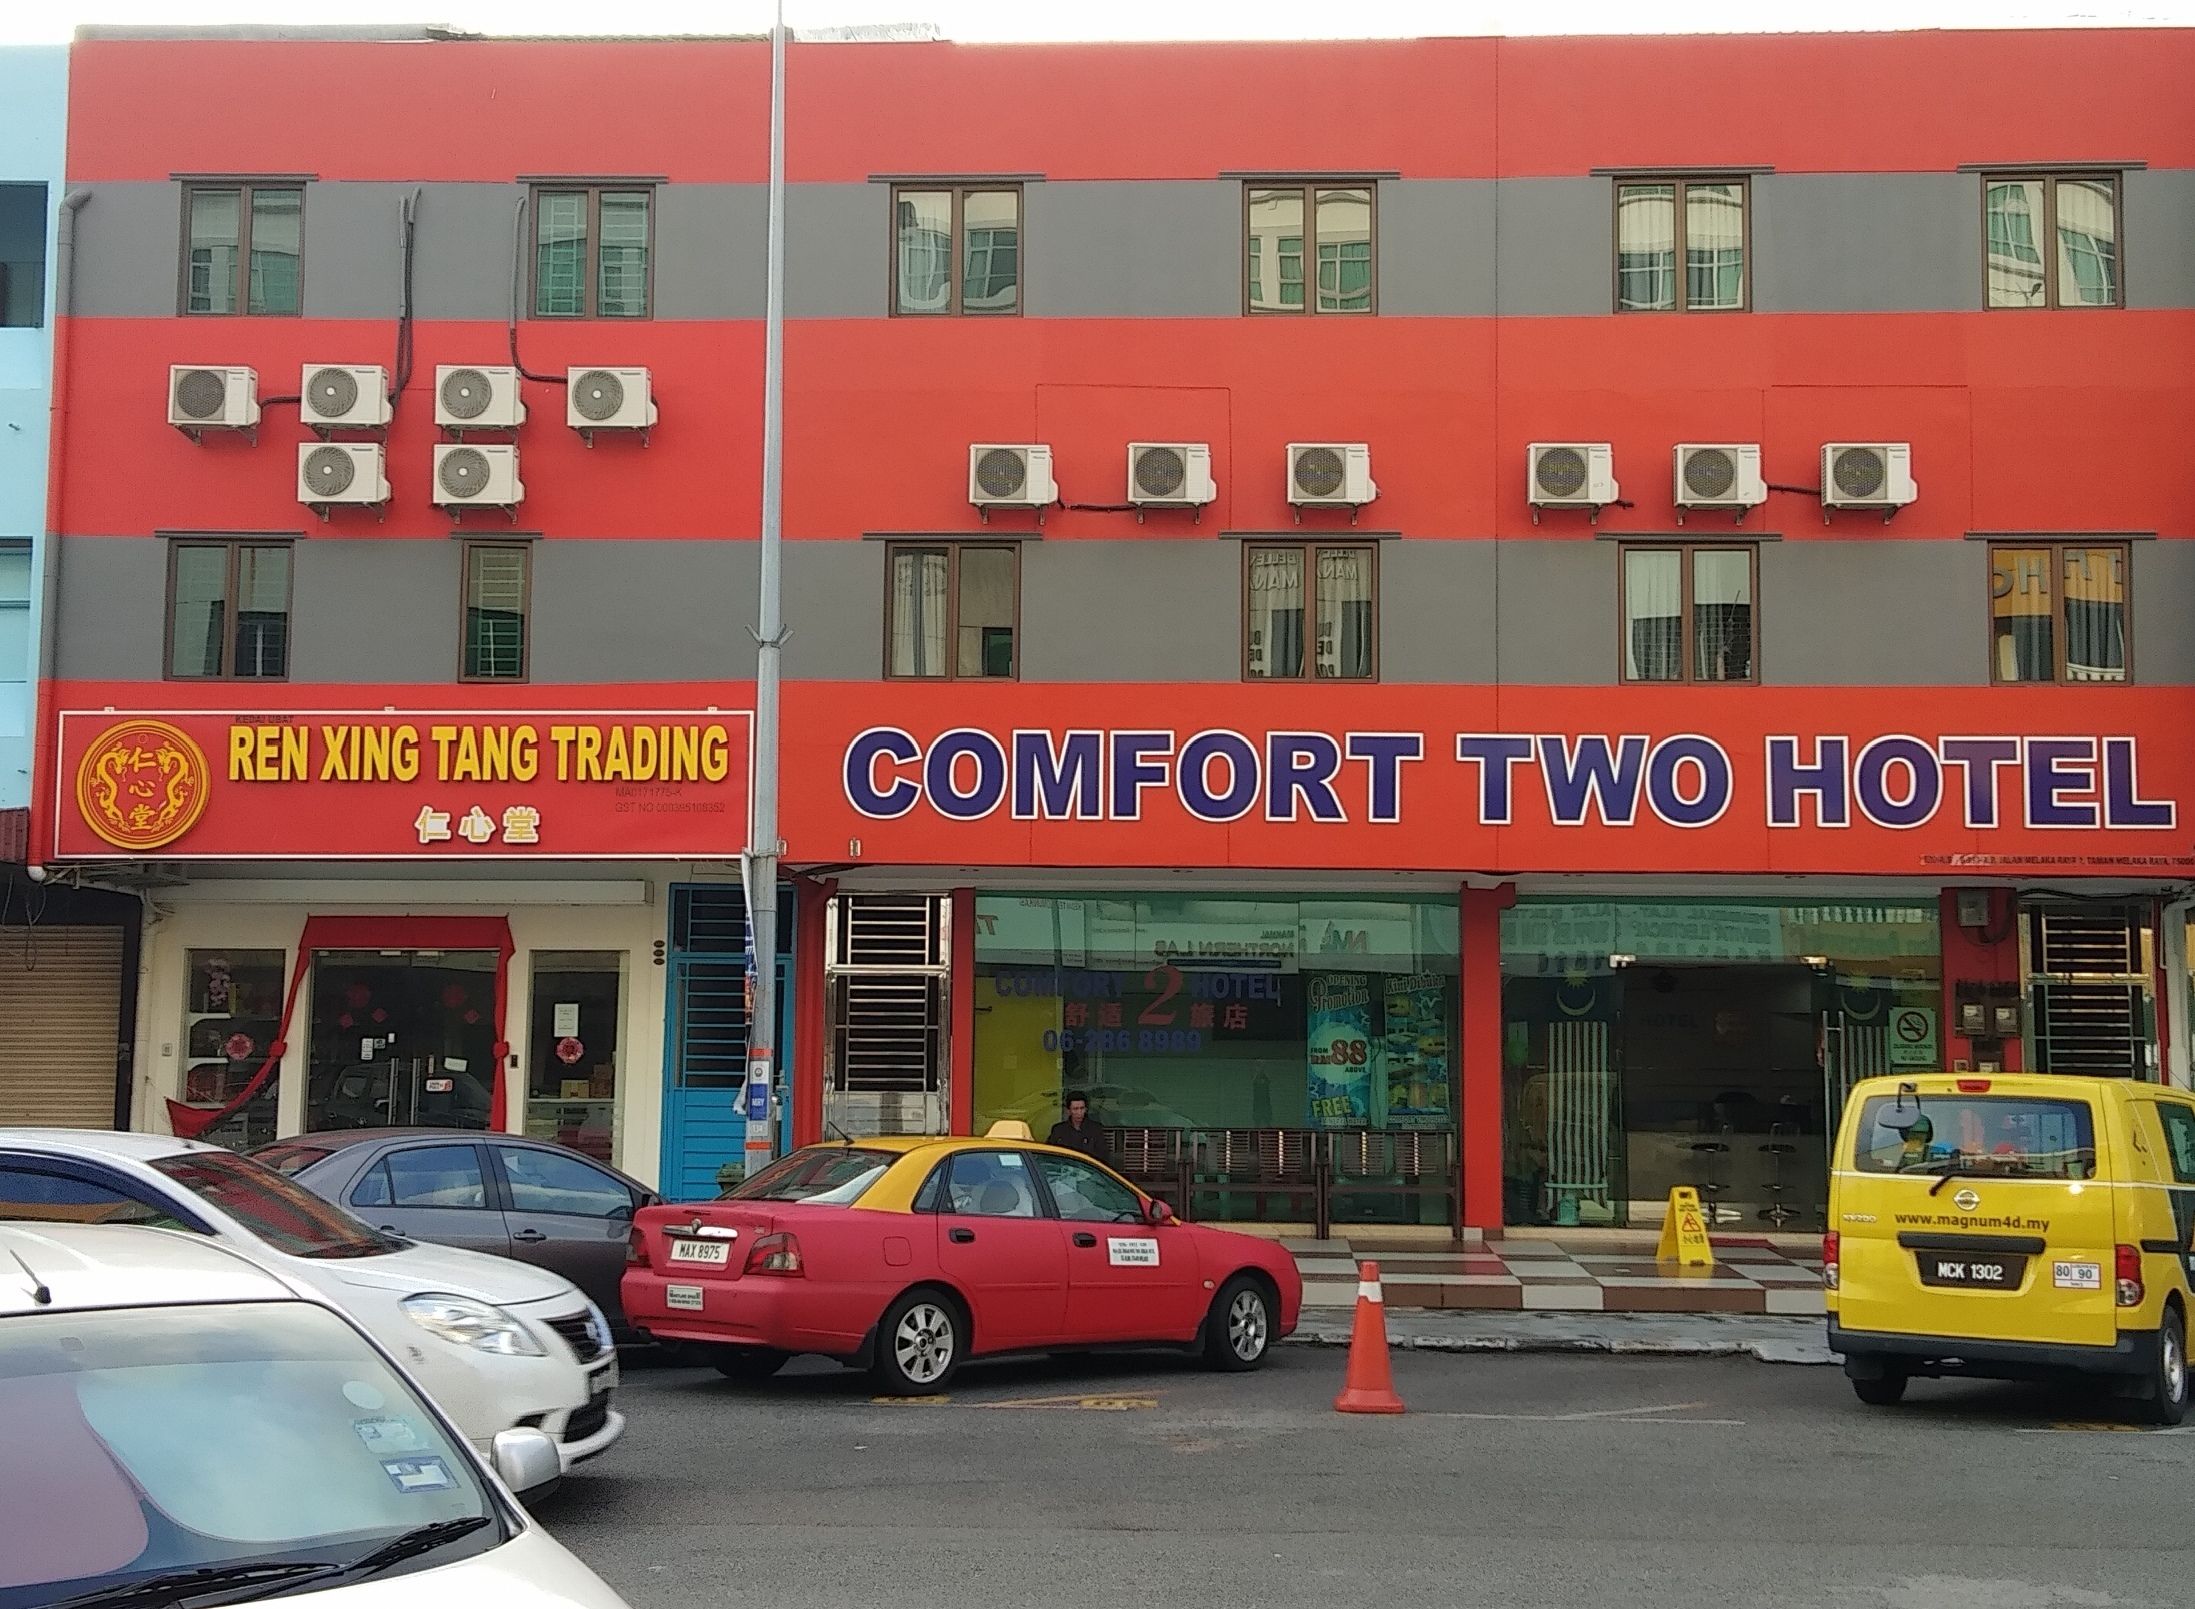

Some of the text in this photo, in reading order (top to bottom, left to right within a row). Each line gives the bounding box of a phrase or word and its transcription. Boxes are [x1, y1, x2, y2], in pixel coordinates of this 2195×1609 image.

[229, 725, 729, 782] REN XING TANG TRADING
[843, 726, 2177, 829] COMFORT TWO HOTEL
[615, 802, 636, 813] GST
[414, 805, 540, 843] 仁心堂
[1326, 974, 1368, 987] OPENING
[1138, 964, 1183, 1026] 2
[1308, 977, 1370, 1013] Promotion
[1331, 1039, 1368, 1066] 88
[1312, 1095, 1352, 1118] FREE
[1895, 1213, 2050, 1233] www.magnum4d.my
[679, 1243, 720, 1260] MAX 8975
[1937, 1261, 2004, 1281] MCK 1302
[2056, 1264, 2070, 1277] 80
[2078, 1268, 2093, 1279] 90
